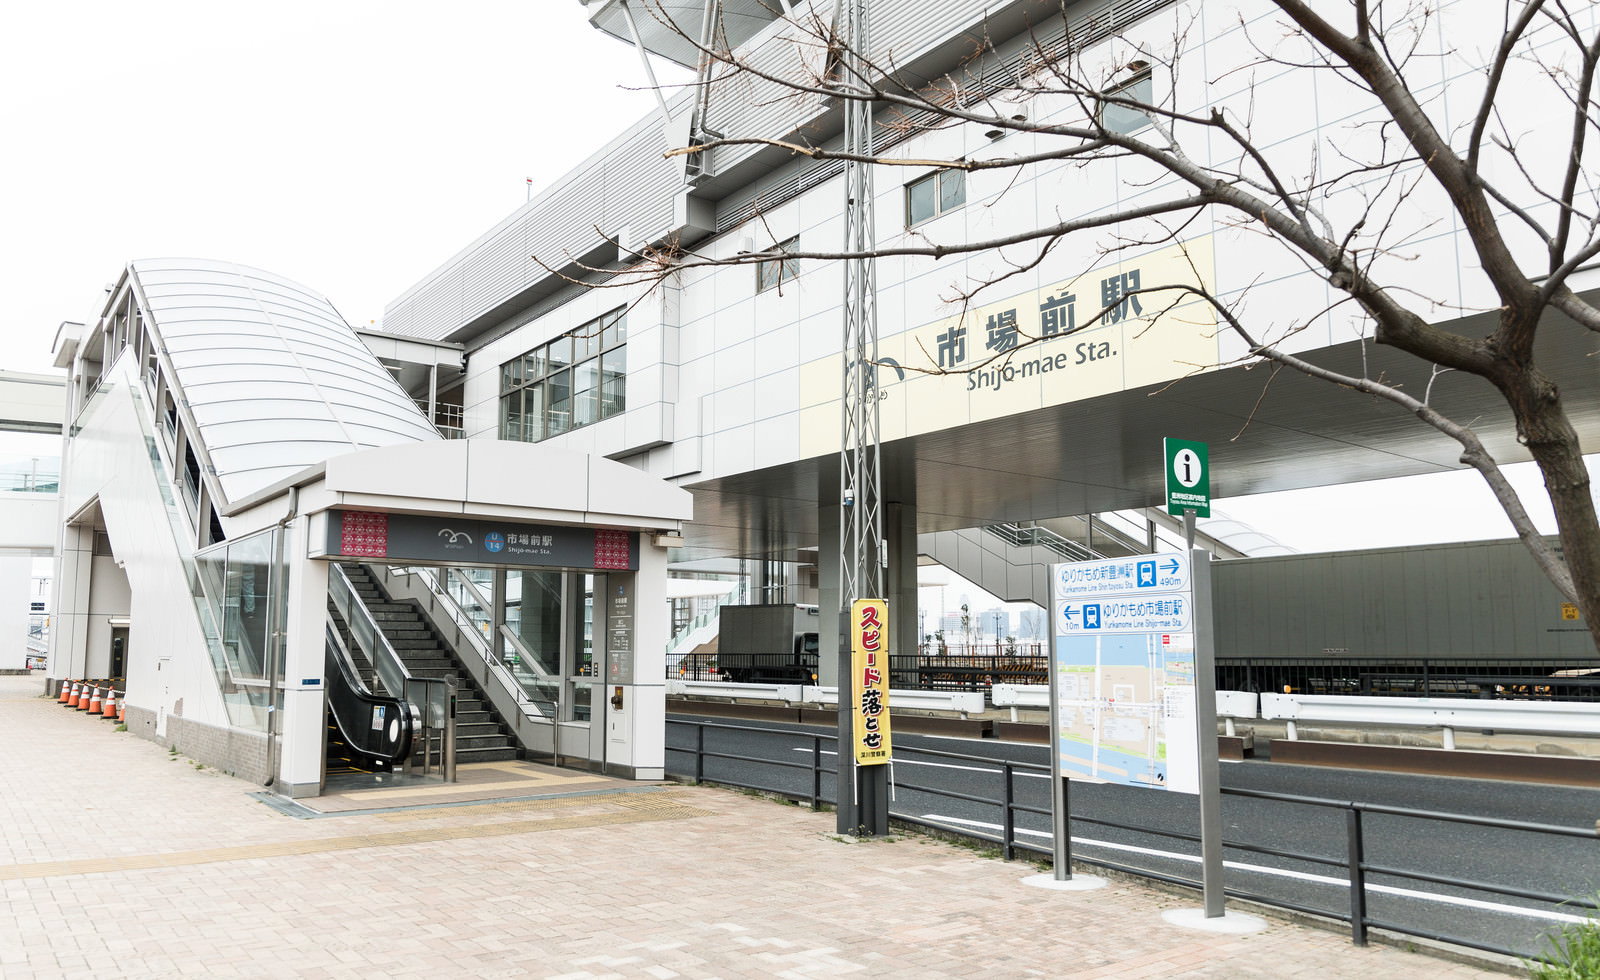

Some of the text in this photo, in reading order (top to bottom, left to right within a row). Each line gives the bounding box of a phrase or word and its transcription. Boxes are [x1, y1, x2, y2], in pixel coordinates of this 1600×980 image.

[936, 269, 1143, 367] 市場前駅
[1075, 341, 1117, 365] Sta.
[491, 532, 498, 540] U
[507, 533, 553, 547] 市場前駅
[489, 542, 500, 550] 14
[1061, 563, 1134, 583] ゆりかもめ新豊洲駅
[1159, 577, 1181, 586] 490m
[1088, 584, 1097, 592] Line
[1103, 600, 1183, 618] ゆりかもめ市場前駅
[1066, 622, 1079, 630] 10m
[1134, 620, 1144, 628] Line
[860, 606, 882, 749] スピード落とせ
